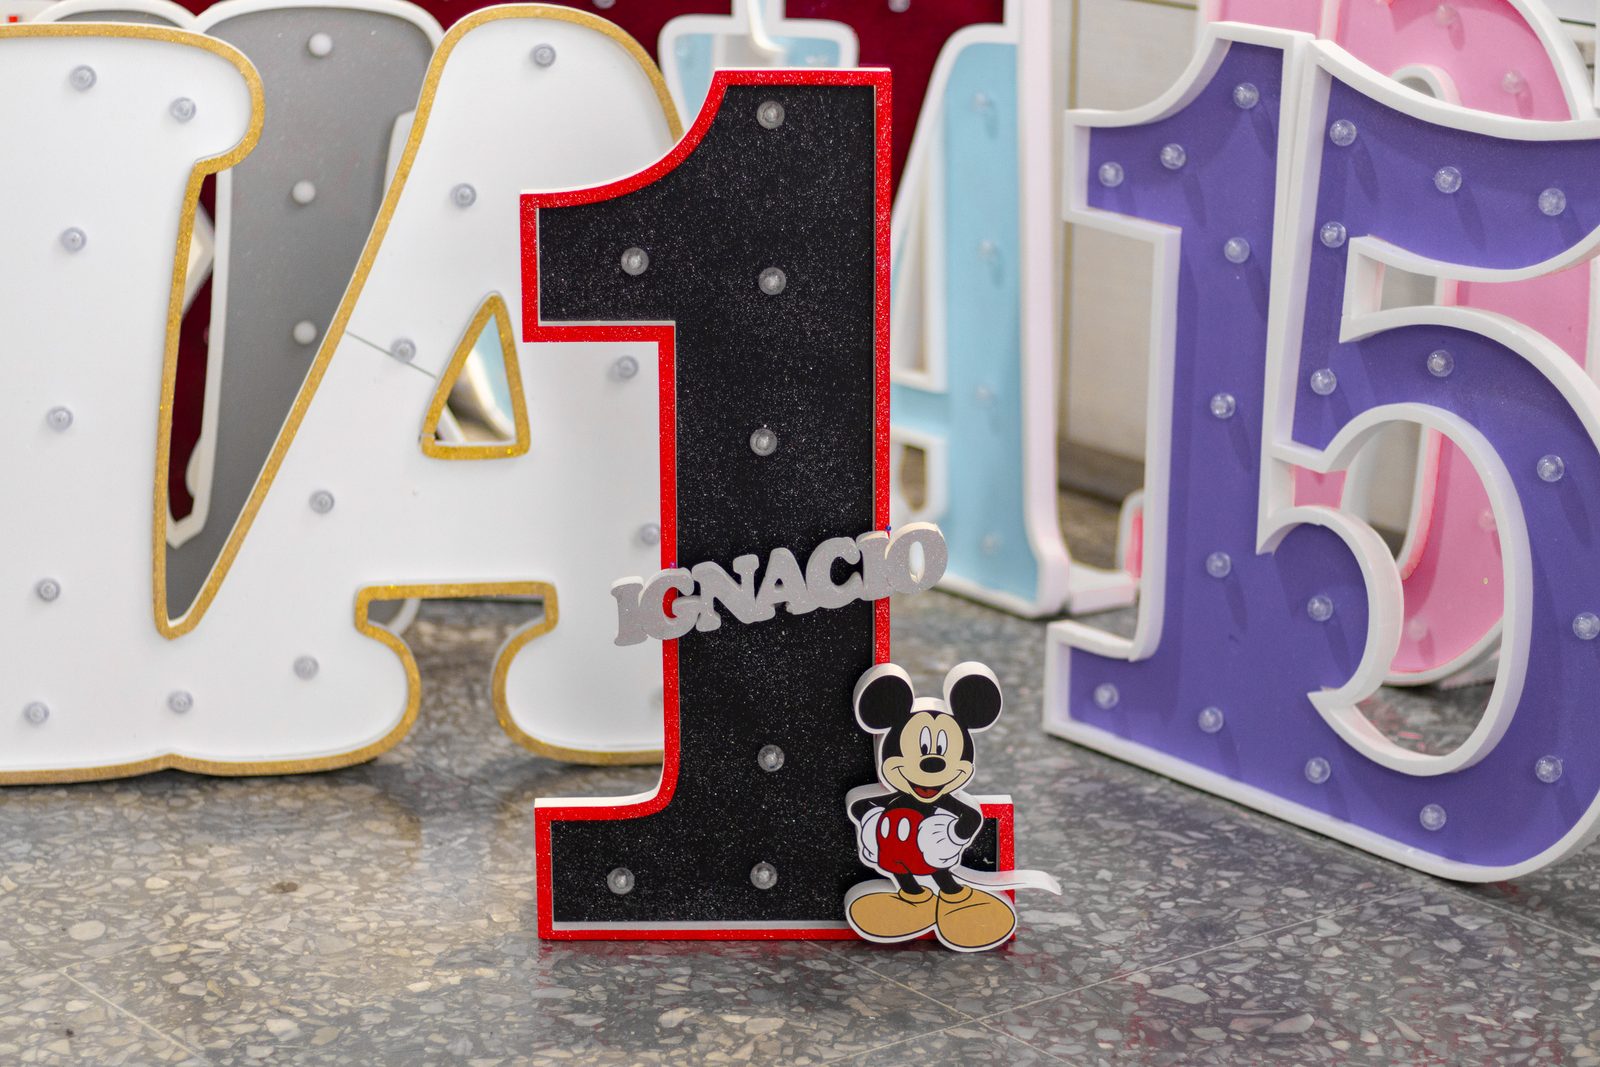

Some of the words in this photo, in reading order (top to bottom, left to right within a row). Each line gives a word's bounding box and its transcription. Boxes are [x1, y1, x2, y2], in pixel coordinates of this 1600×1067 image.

[521, 66, 1017, 942] 1
[610, 521, 948, 647] IGNACIO
[1043, 21, 1600, 884] 15
